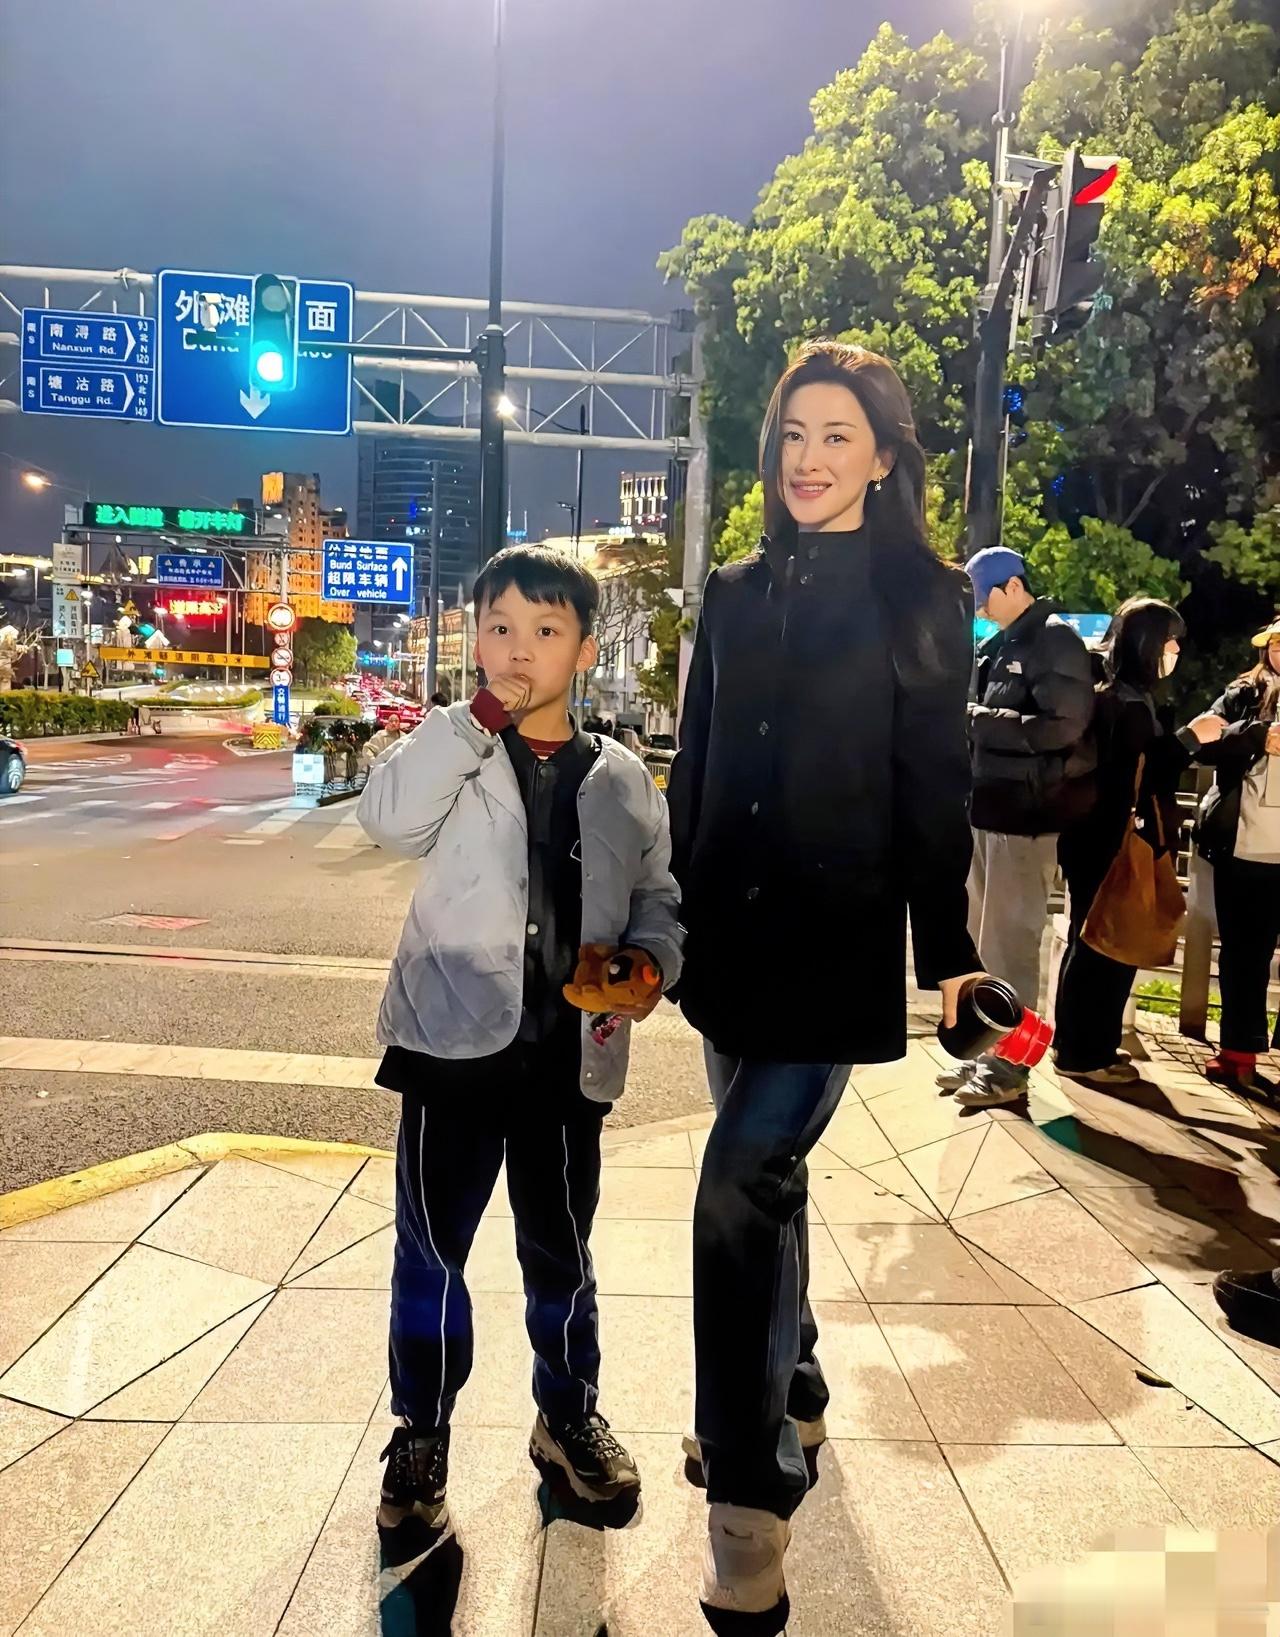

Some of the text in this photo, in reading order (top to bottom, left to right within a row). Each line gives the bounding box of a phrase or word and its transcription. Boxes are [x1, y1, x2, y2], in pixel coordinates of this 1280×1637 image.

[175, 290, 338, 332] 外滩面
[50, 323, 117, 341] 南浔路
[28, 335, 35, 344] S
[52, 342, 116, 355] Nanxun Rd.
[140, 345, 148, 353] N
[136, 354, 149, 364] 120
[48, 375, 114, 392] 塘沽路
[136, 373, 148, 384] 193
[28, 390, 35, 398] S
[51, 393, 113, 405] Tanggu Rd.
[138, 397, 146, 406] N
[135, 406, 148, 417] 149
[329, 559, 388, 572] Bund Surface
[327, 571, 389, 588] 超限车辆
[329, 587, 388, 599] Over vehicle
